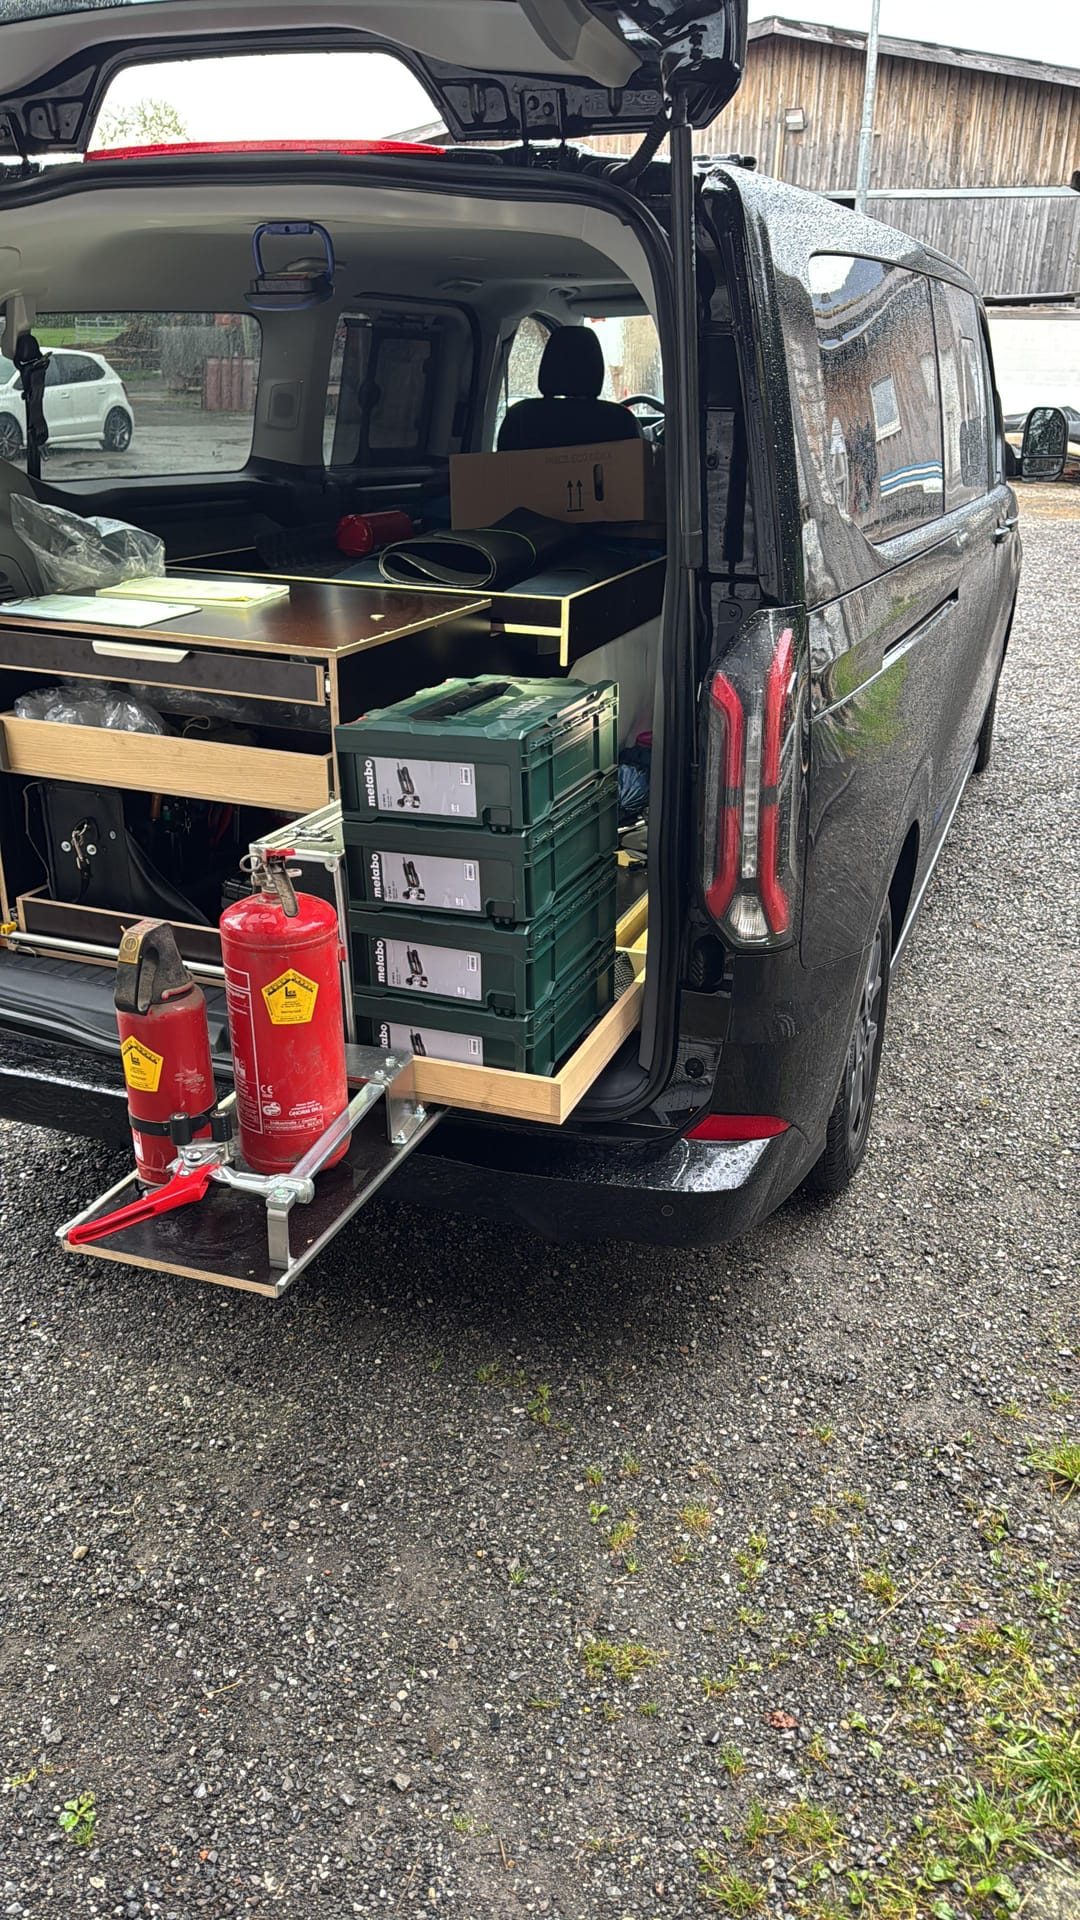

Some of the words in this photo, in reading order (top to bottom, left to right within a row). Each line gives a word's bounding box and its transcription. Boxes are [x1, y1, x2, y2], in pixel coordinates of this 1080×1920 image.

[496, 695, 553, 719] metabo
[364, 759, 378, 807] metabo
[370, 853, 382, 898] metabo
[375, 940, 385, 983] metabo
